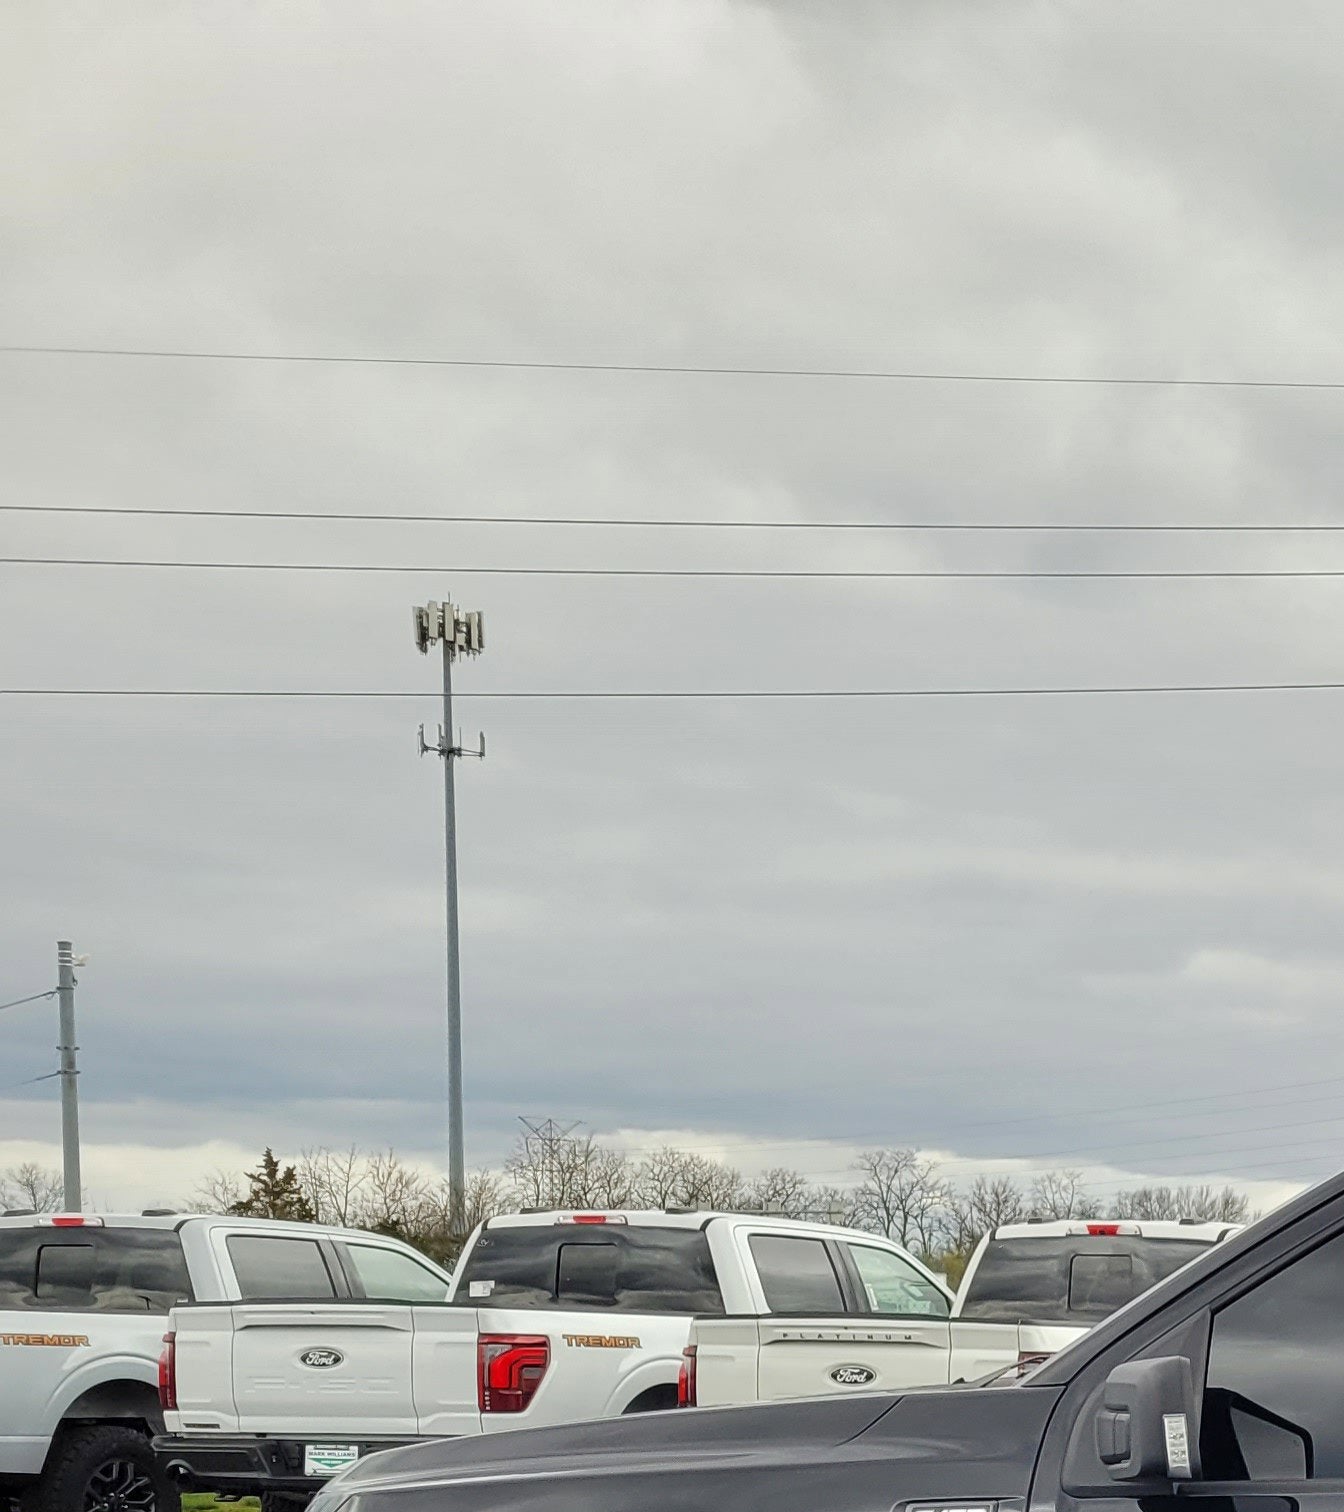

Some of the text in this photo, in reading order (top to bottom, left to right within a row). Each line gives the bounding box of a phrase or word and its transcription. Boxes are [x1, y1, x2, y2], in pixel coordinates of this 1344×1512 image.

[0, 1333, 91, 1347] TREMOR
[562, 1334, 643, 1349] TREMOR
[782, 1332, 912, 1341] PLATINUM
[304, 1350, 336, 1366] Ford
[835, 1368, 869, 1384] Ford
